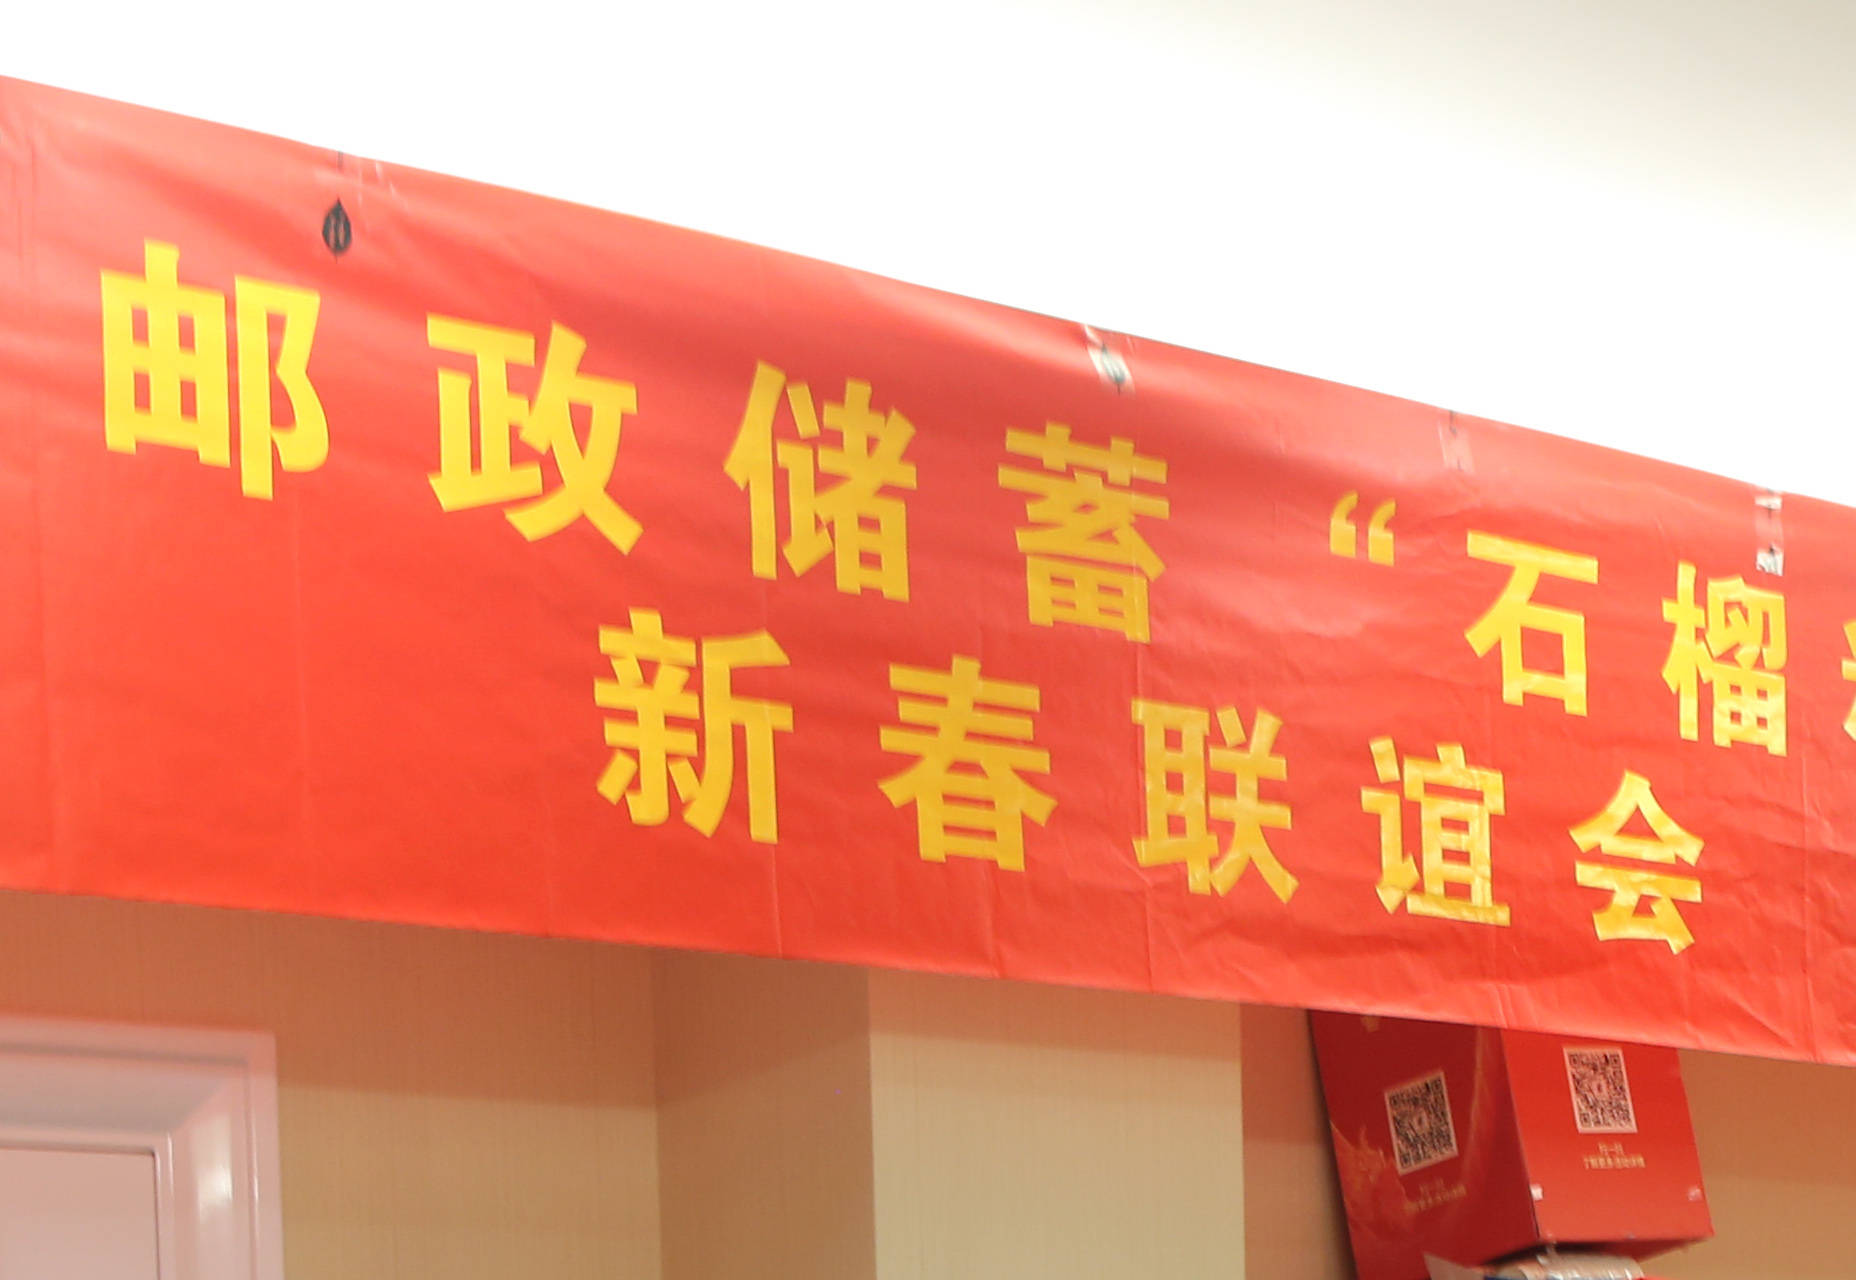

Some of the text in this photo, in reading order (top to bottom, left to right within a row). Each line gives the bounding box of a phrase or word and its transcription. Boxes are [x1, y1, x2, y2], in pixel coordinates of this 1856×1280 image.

[593, 608, 1706, 956] 新春联谊会
